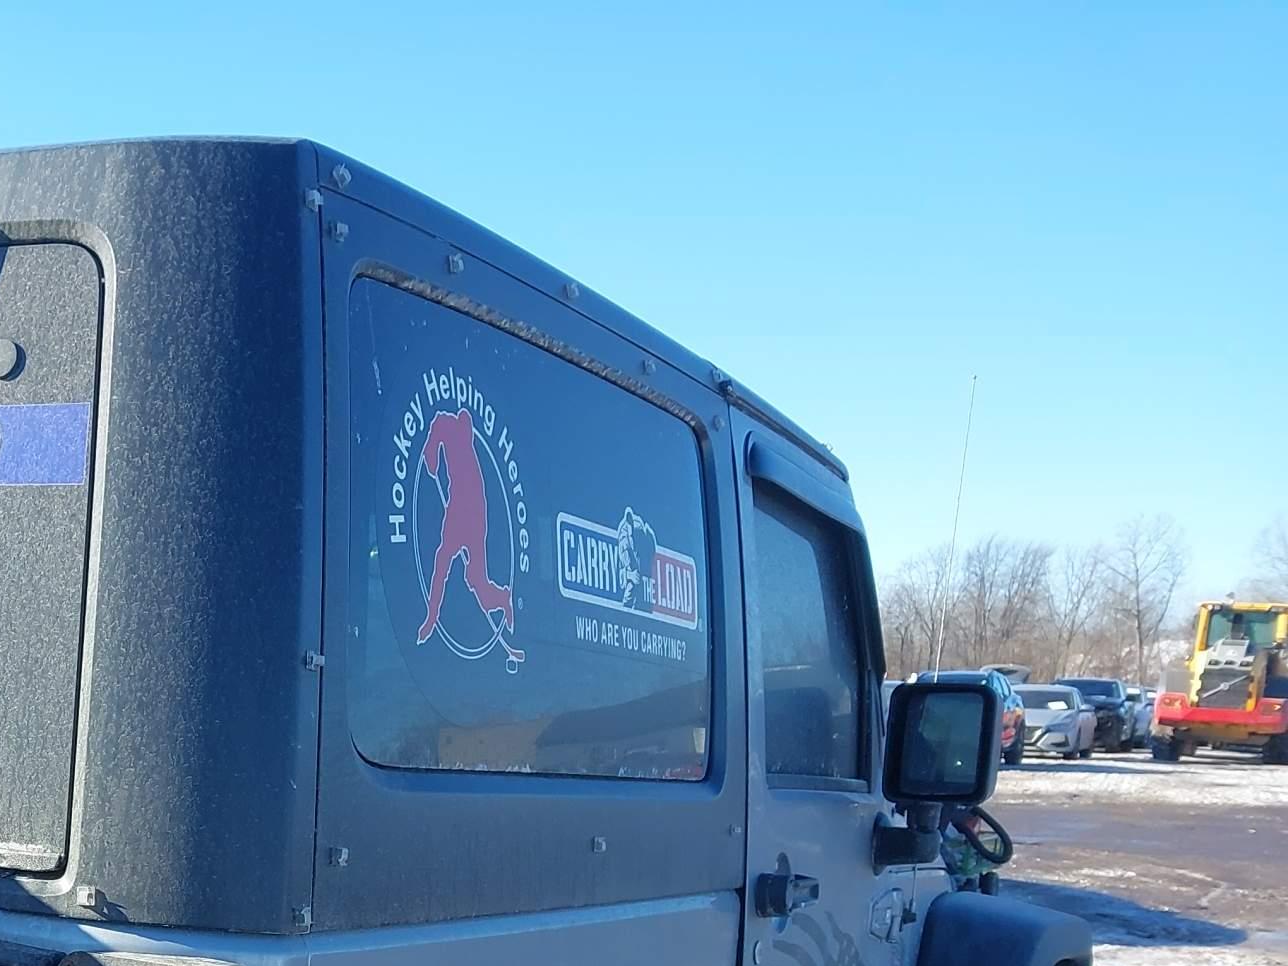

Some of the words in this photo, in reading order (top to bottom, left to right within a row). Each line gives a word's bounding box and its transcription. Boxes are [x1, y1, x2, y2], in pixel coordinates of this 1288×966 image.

[389, 391, 425, 543] Hockey
[423, 367, 496, 437] Helping
[498, 427, 530, 573] Heroes
[563, 530, 618, 593] CARRY
[642, 576, 656, 604] THE
[656, 560, 693, 614] LOAD
[576, 616, 598, 643] WHO
[601, 622, 620, 646] ARE
[621, 625, 639, 651] YOU
[641, 632, 687, 661] CARRYING?
